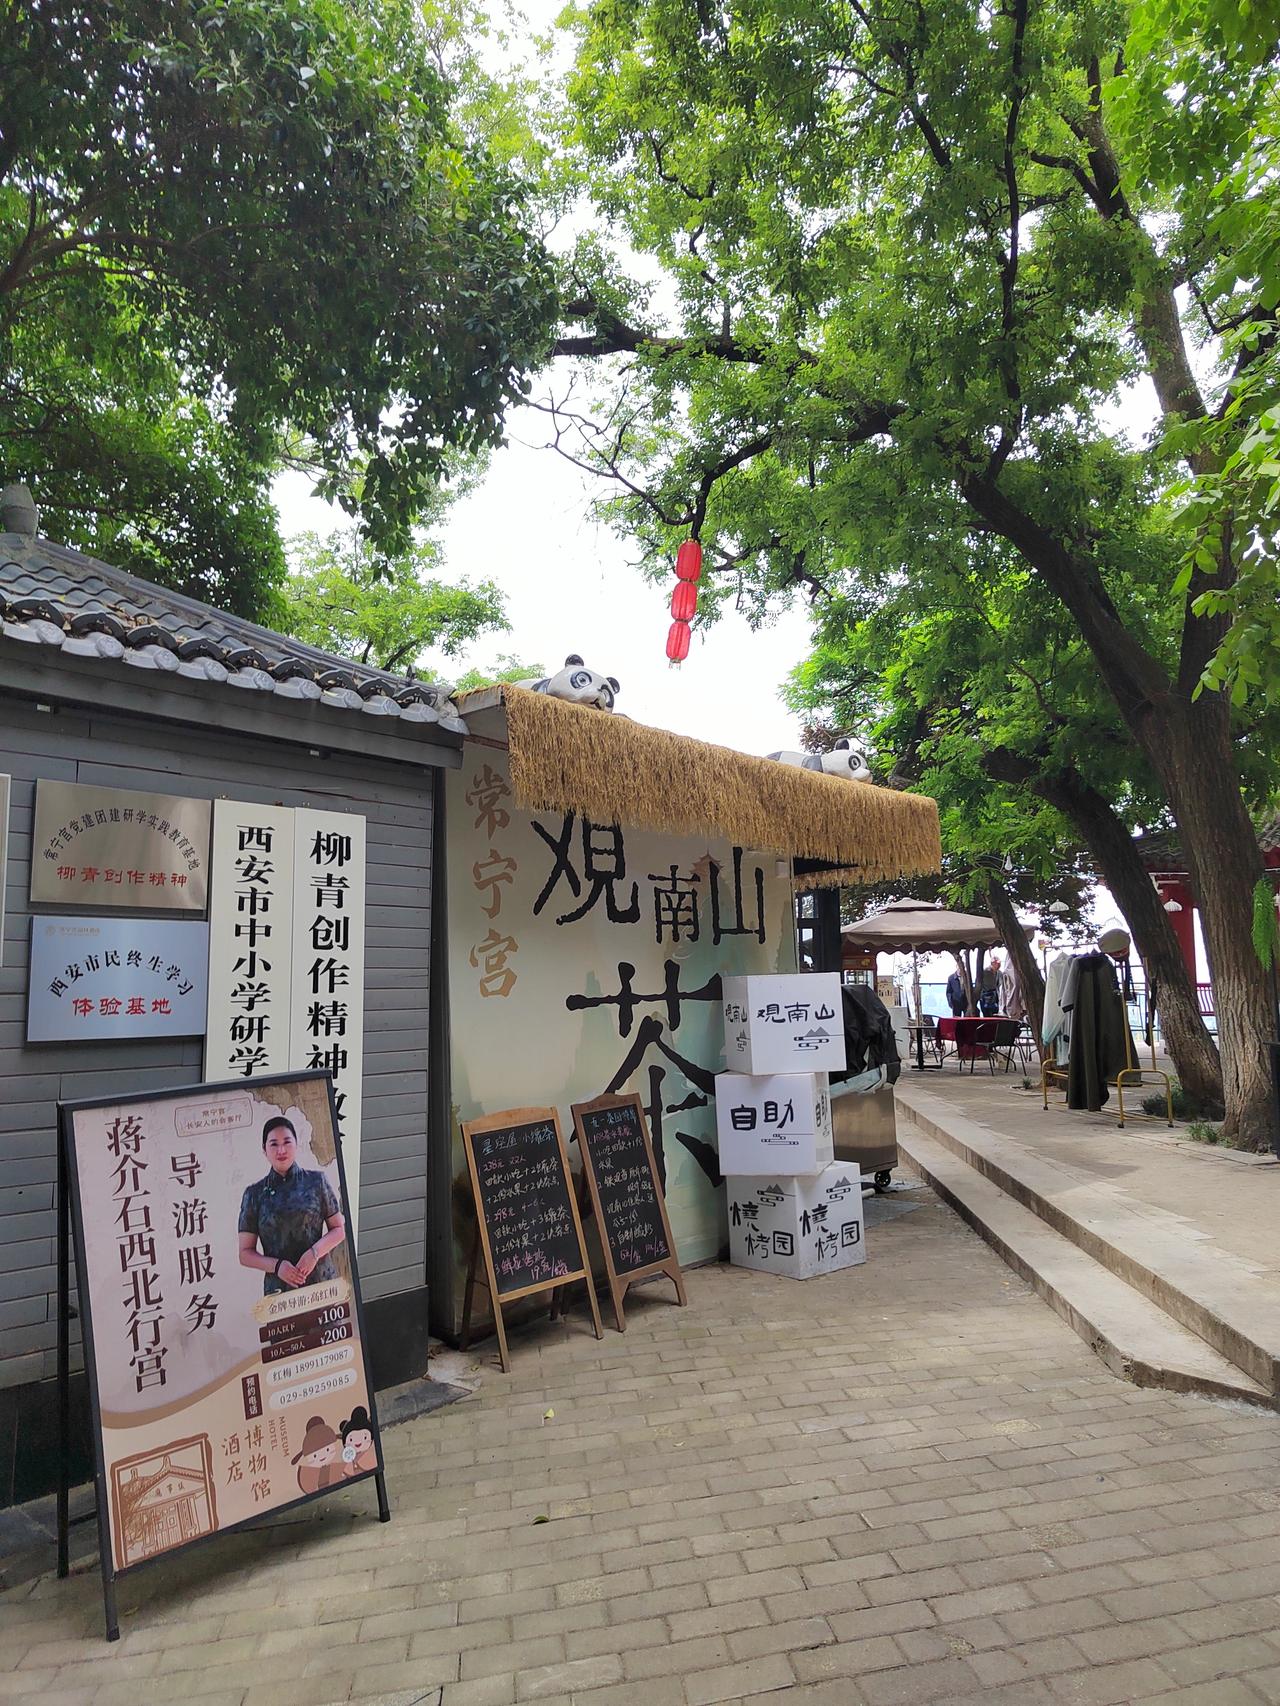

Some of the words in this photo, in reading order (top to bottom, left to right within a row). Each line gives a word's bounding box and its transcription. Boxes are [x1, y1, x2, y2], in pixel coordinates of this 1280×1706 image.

[56, 865, 188, 888] 柳青创作精神
[465, 763, 518, 998] 常宁宫
[530, 808, 765, 946] 观南山
[48, 949, 194, 998] 西安市民终生学习
[228, 825, 276, 1077] 西安市中小学研学
[72, 997, 172, 1018] 体验基地
[757, 1002, 836, 1024] 观南山
[730, 1099, 794, 1131] 自助
[104, 1116, 168, 1393] 蒋介石西北行宫
[168, 1152, 219, 1336] 导游服务
[280, 1374, 350, 1405] 029-89259085
[221, 1432, 244, 1487] 酒店
[268, 1419, 278, 1451] HOTEL
[279, 1416, 290, 1457] MUSEUM
[244, 1424, 271, 1502] 博物馆
